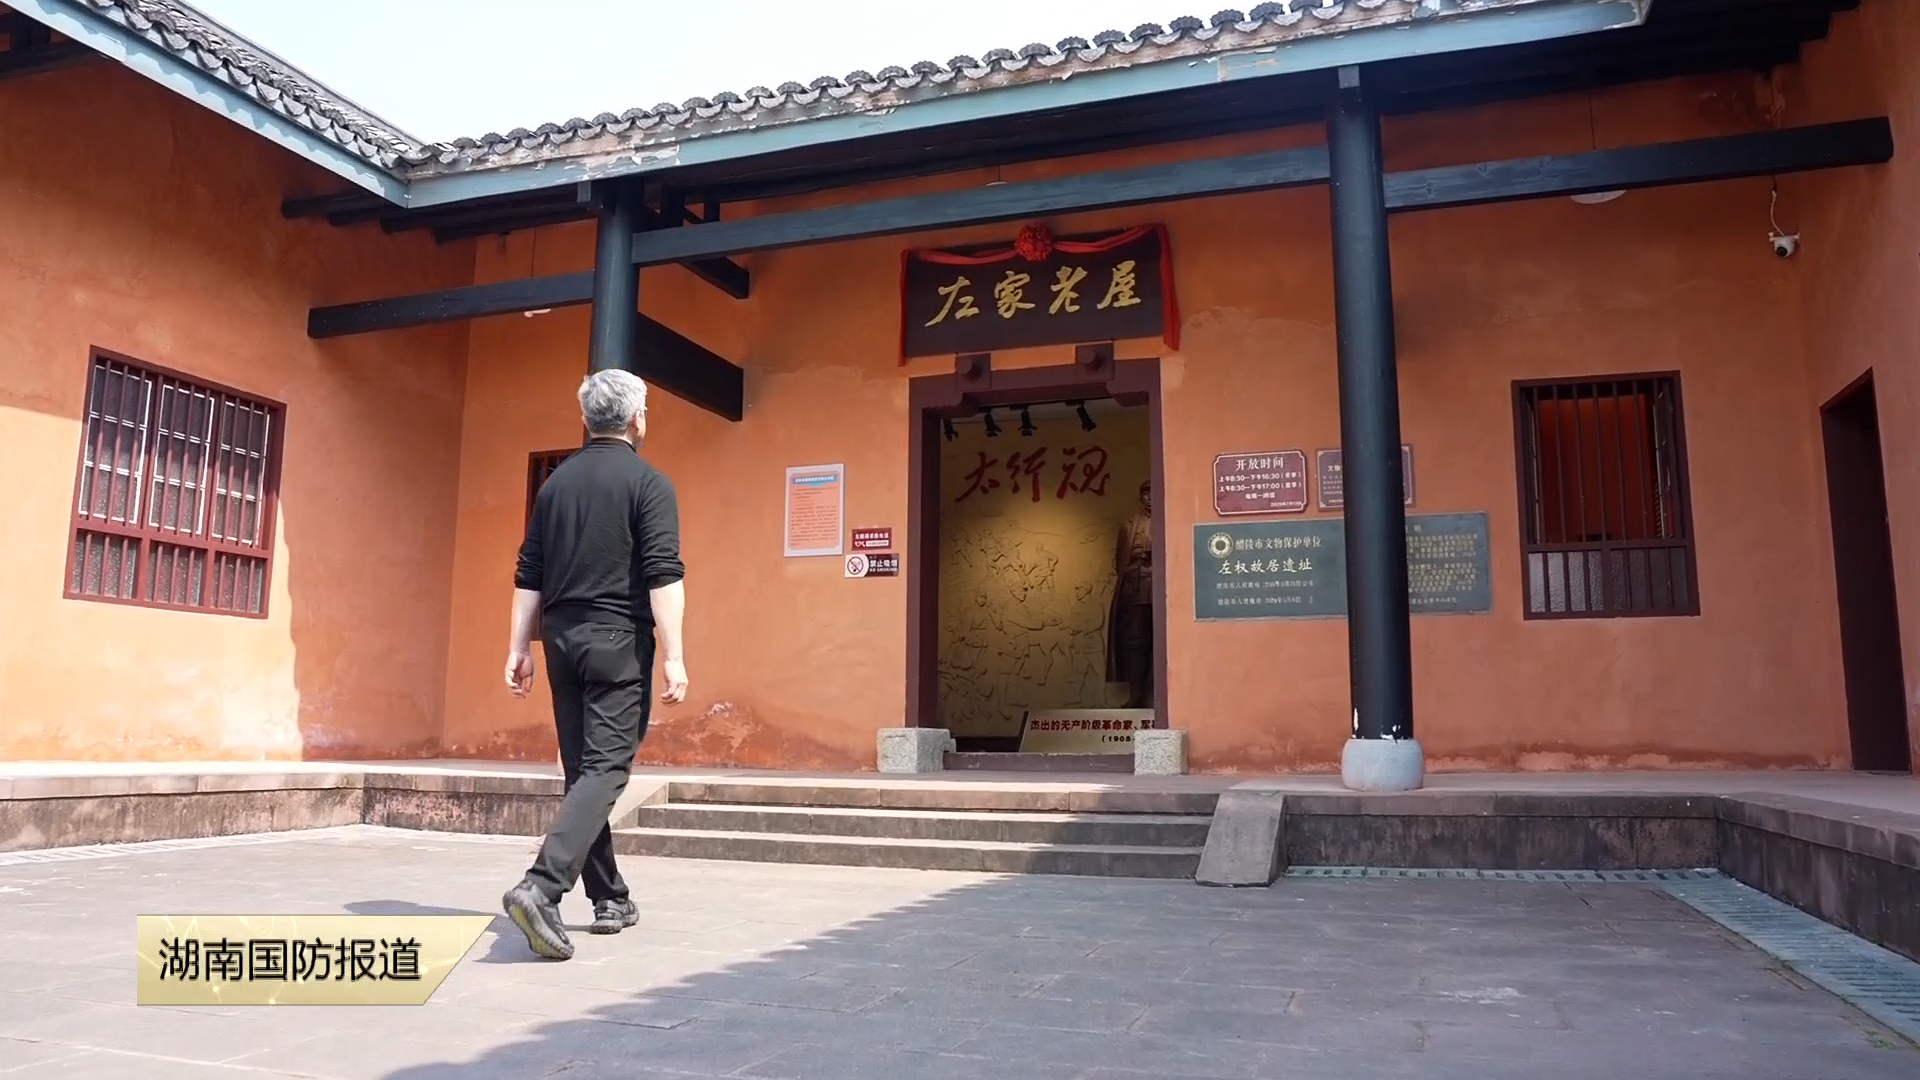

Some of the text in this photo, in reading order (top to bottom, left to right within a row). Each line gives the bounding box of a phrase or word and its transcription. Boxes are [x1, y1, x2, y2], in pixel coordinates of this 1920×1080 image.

[924, 260, 1142, 327] 左家老屋
[1235, 457, 1284, 471] 开放时间
[955, 446, 1110, 502] 太行魂
[1235, 536, 1321, 550] 醴陵市文物保护单位
[1218, 558, 1312, 575] 左权故居遗址
